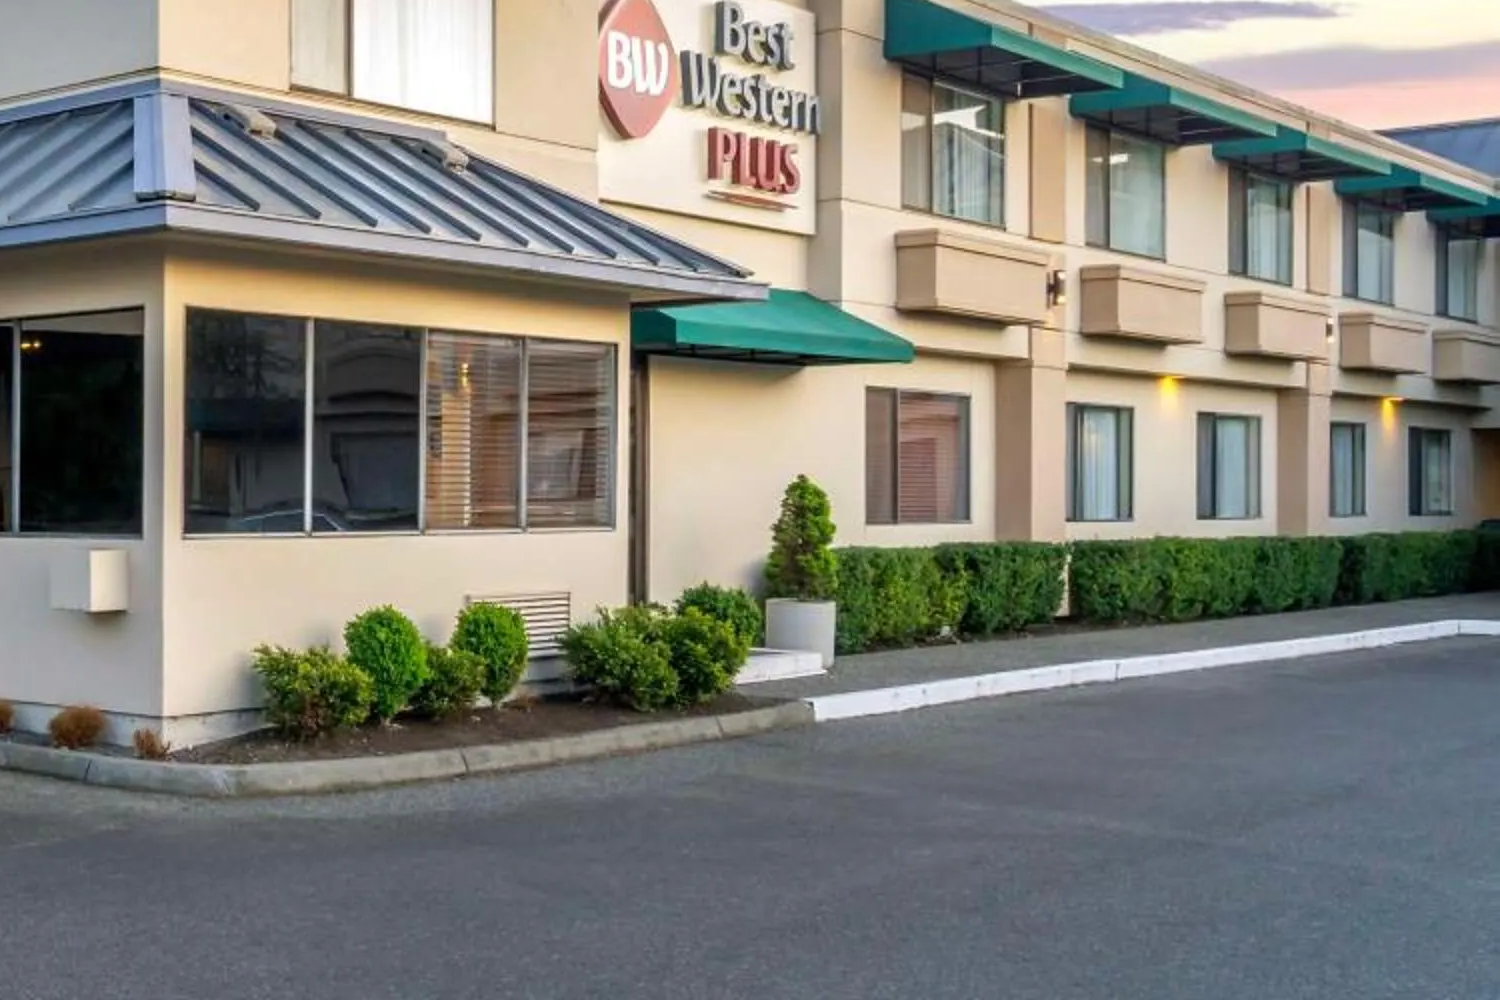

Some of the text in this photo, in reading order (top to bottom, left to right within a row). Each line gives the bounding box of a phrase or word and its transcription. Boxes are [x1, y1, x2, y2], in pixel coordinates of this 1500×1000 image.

[607, 30, 670, 96] BW
[715, 0, 796, 71] Best
[680, 49, 822, 136] Western
[708, 126, 801, 194] PLUS
